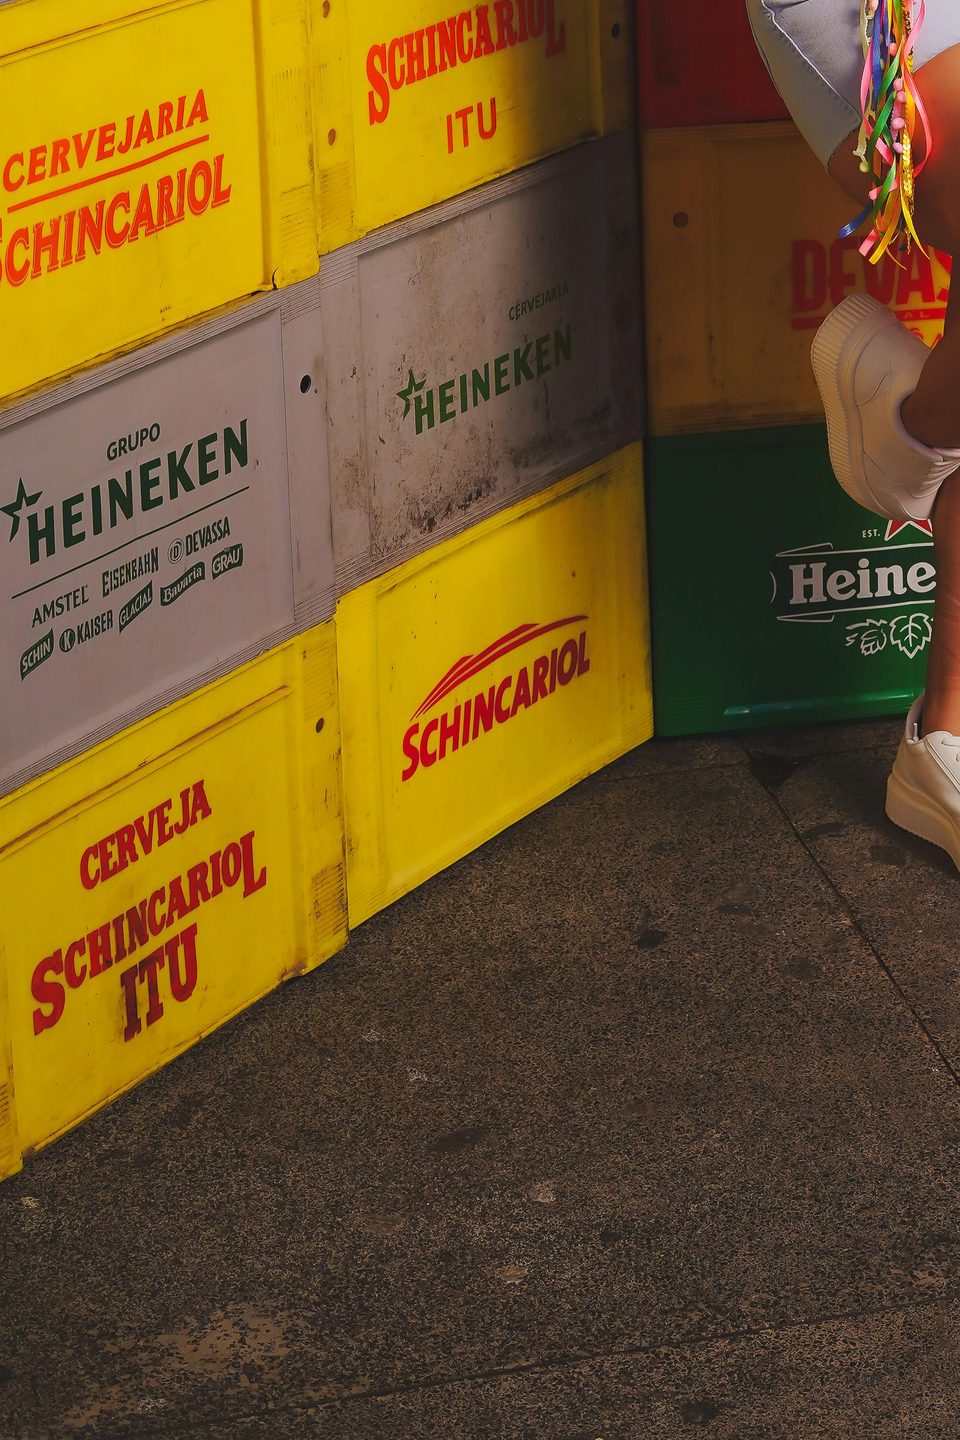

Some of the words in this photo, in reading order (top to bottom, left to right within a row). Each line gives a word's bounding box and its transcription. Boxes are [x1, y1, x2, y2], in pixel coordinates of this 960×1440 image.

[2, 88, 209, 193] CERVEJARIA
[446, 97, 497, 154] ITU
[0, 153, 232, 288] CHINCARIOL
[509, 282, 569, 322] CERVEJARIA
[414, 323, 573, 436] HEINEKEN
[27, 418, 248, 565] HEINEKEN
[107, 423, 161, 461] GRUPO
[32, 584, 89, 628] AMSTEL
[102, 546, 159, 598] EISENBAHN
[185, 516, 231, 556] DEVASSA
[788, 558, 937, 605] Heine
[862, 529, 881, 538] EST.
[22, 638, 51, 674] SCHIN
[77, 609, 113, 644] KAISER
[120, 588, 152, 626] GLACIAL
[163, 566, 202, 603] Bavaria
[212, 550, 241, 575] GRAU
[401, 631, 591, 782] SCHINCARIOL
[80, 779, 212, 890] CERVEJA
[31, 830, 267, 1037] SCHINCARIOL
[120, 924, 199, 1043] ITU
